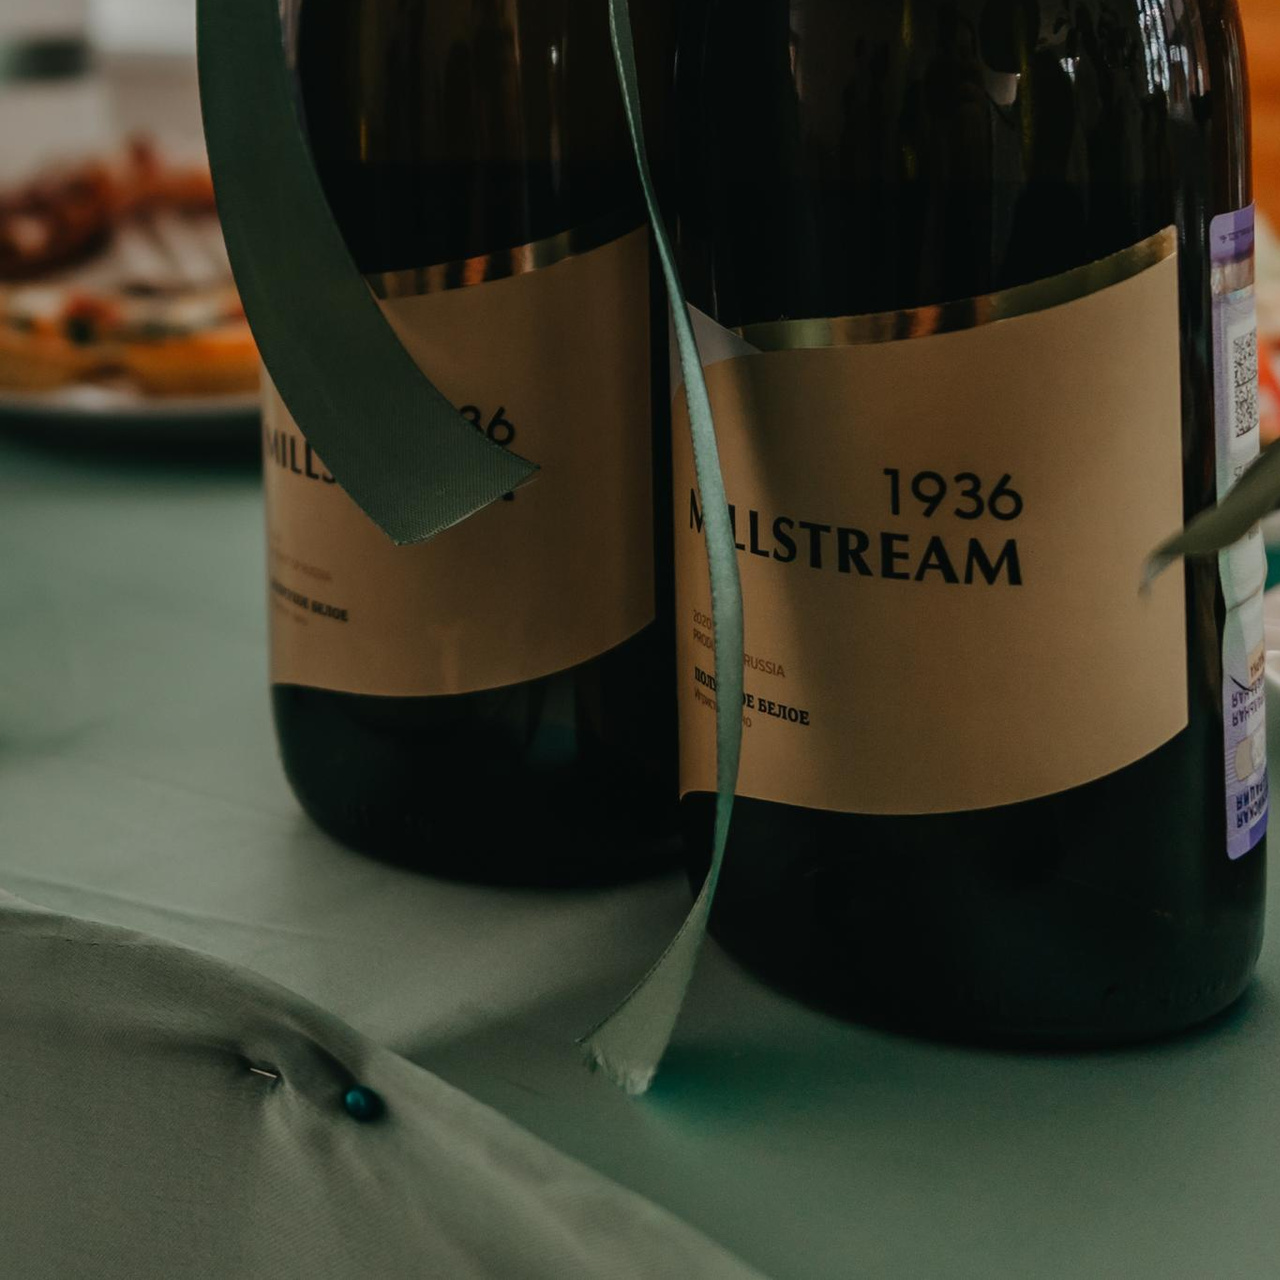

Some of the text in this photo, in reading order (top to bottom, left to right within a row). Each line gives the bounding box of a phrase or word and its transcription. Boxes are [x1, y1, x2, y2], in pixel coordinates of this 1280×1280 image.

[883, 467, 1024, 521] 1936
[689, 488, 1023, 587] MLLSTREAM
[743, 653, 786, 678] RUSSIA
[757, 697, 811, 726] БЕЛОЕ
